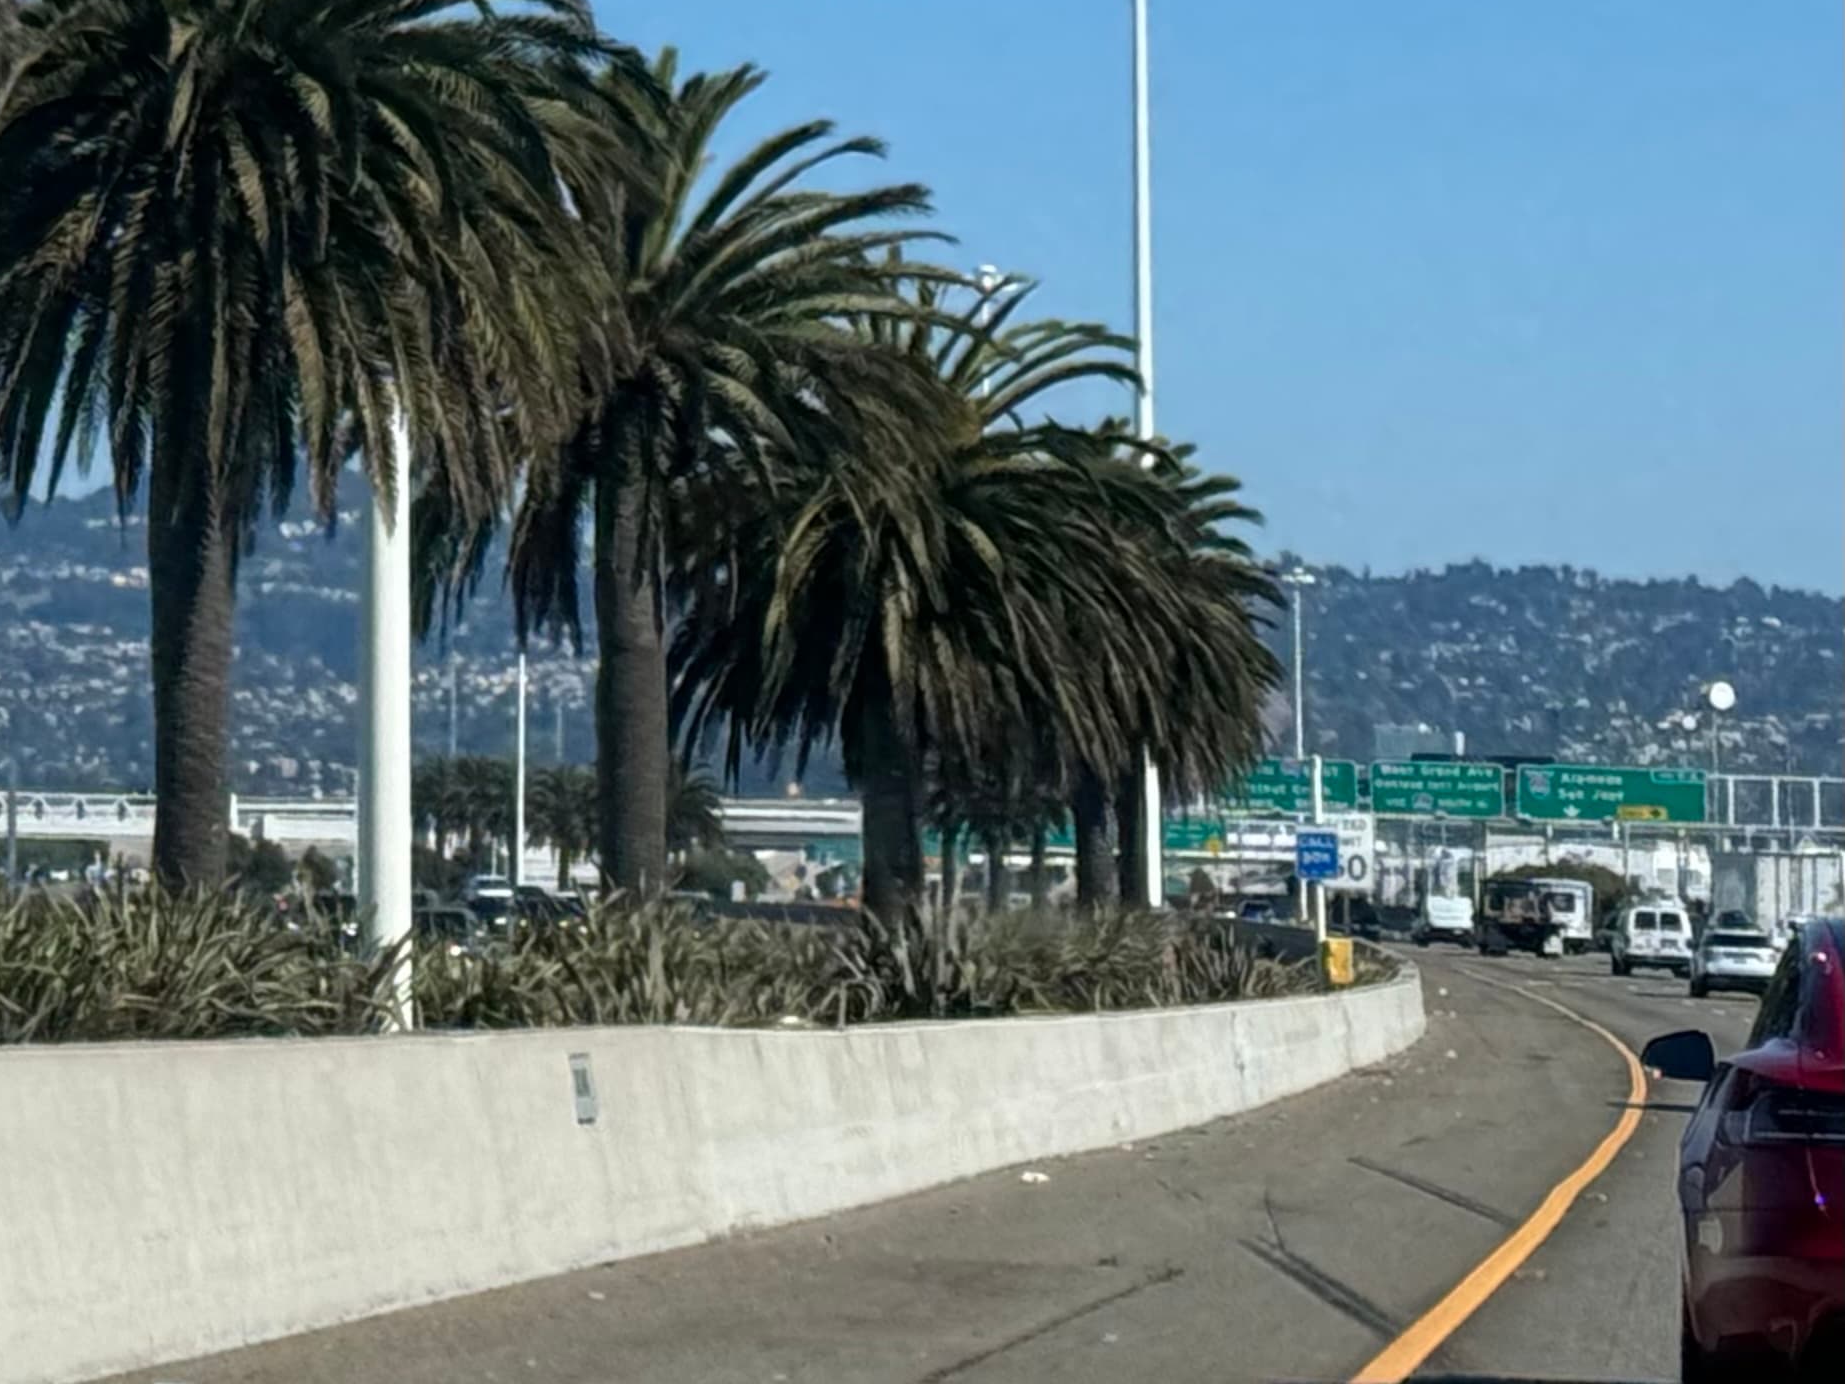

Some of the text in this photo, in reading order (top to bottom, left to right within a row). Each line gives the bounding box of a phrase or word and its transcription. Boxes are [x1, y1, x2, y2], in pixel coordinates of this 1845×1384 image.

[1380, 765, 1494, 778] West Grand Ave
[1560, 773, 1622, 786] Alameda
[1374, 780, 1423, 790] Oakland
[1457, 782, 1499, 793] Airport
[1557, 788, 1585, 801] San
[1299, 836, 1335, 848] CALL
